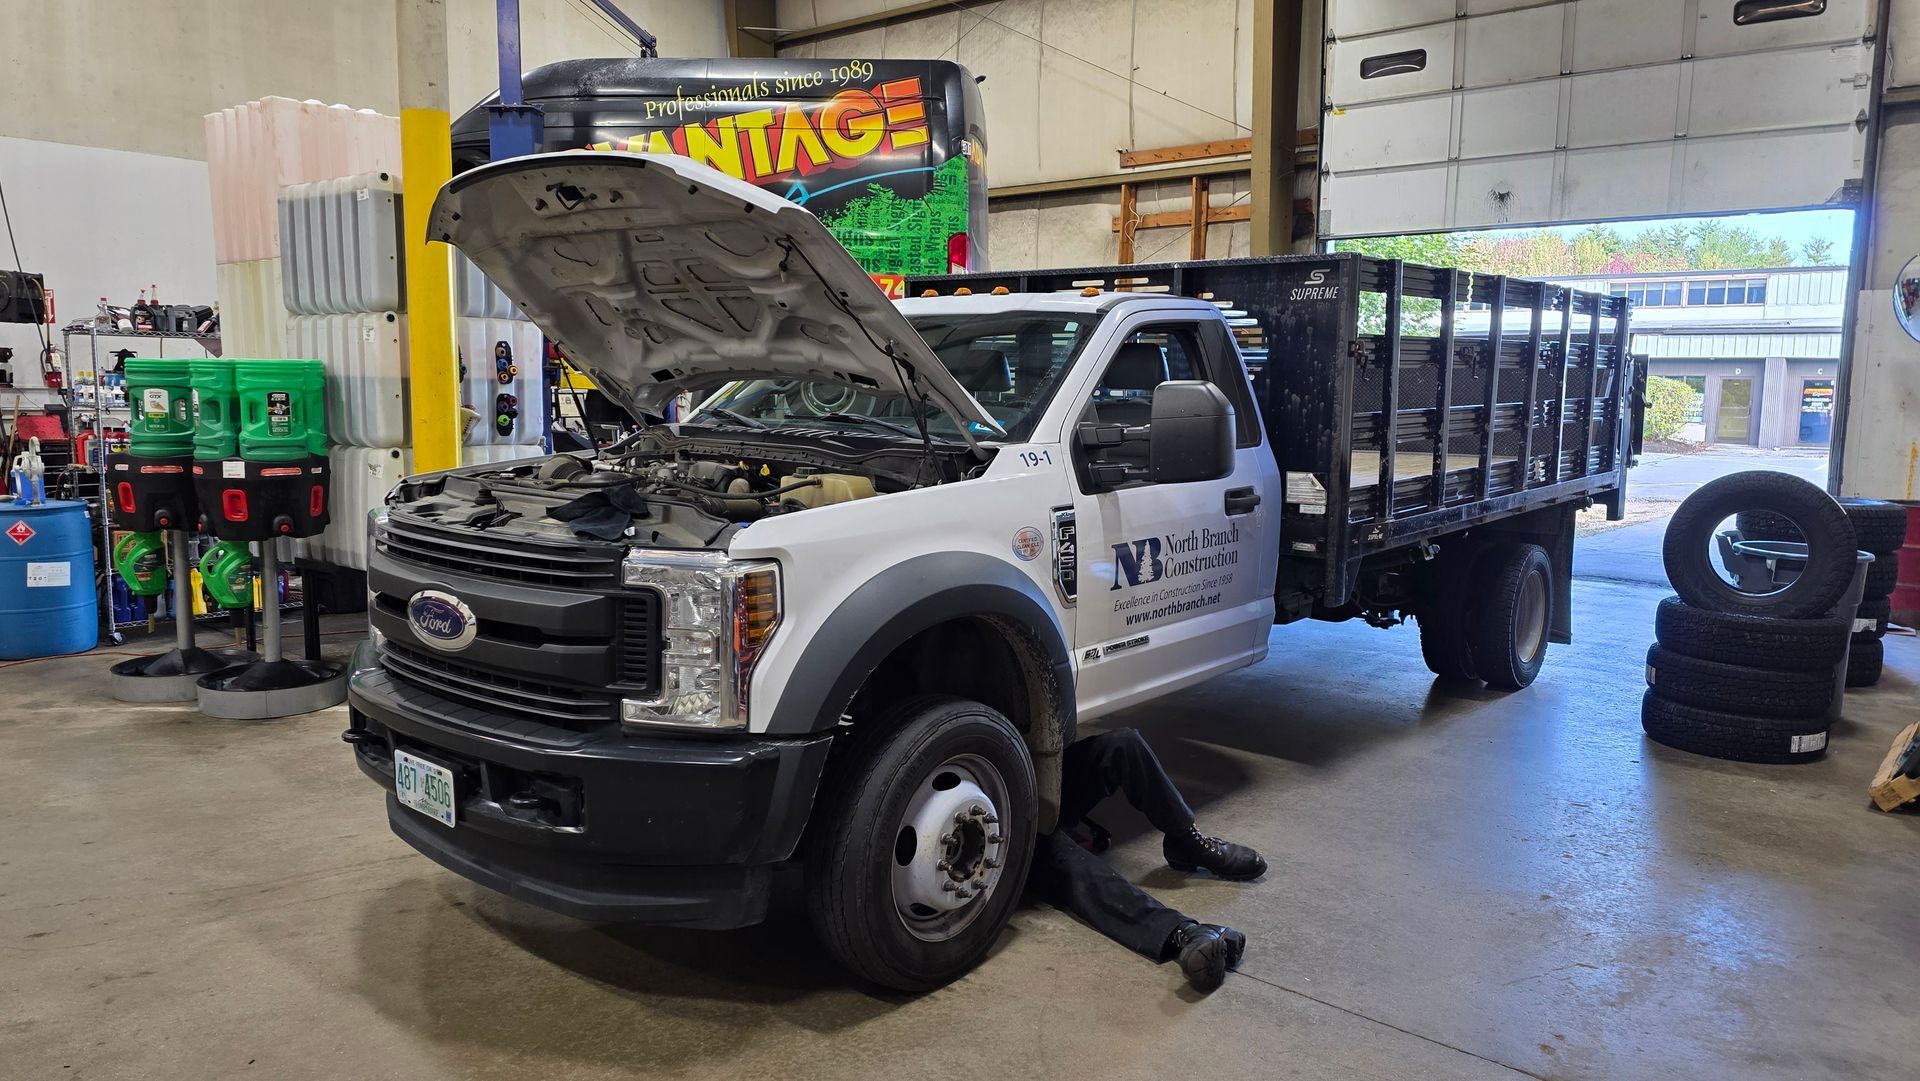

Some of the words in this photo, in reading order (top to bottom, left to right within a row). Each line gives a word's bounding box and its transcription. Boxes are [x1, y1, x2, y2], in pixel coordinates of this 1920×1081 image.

[644, 71, 769, 121] Professionals
[775, 69, 823, 95] since
[830, 59, 874, 87] 1989
[590, 75, 930, 182] NTAGE
[885, 237, 903, 274] igital
[1290, 286, 1340, 301] SUPREME
[1019, 450, 1052, 468] 19-1
[1165, 530, 1199, 556] North
[1202, 522, 1240, 549] Branch
[1110, 537, 1163, 591] NB
[1164, 547, 1239, 579] Construction
[1114, 595, 1150, 612] Excellence
[1152, 592, 1158, 604] in
[1160, 582, 1200, 600] Construction
[1201, 579, 1217, 592] Since
[1219, 573, 1233, 585] 1958
[1126, 592, 1221, 626] www.northbranch.net
[420, 605, 451, 634] Ford
[397, 763, 417, 794] 487
[424, 773, 451, 809] 4506
